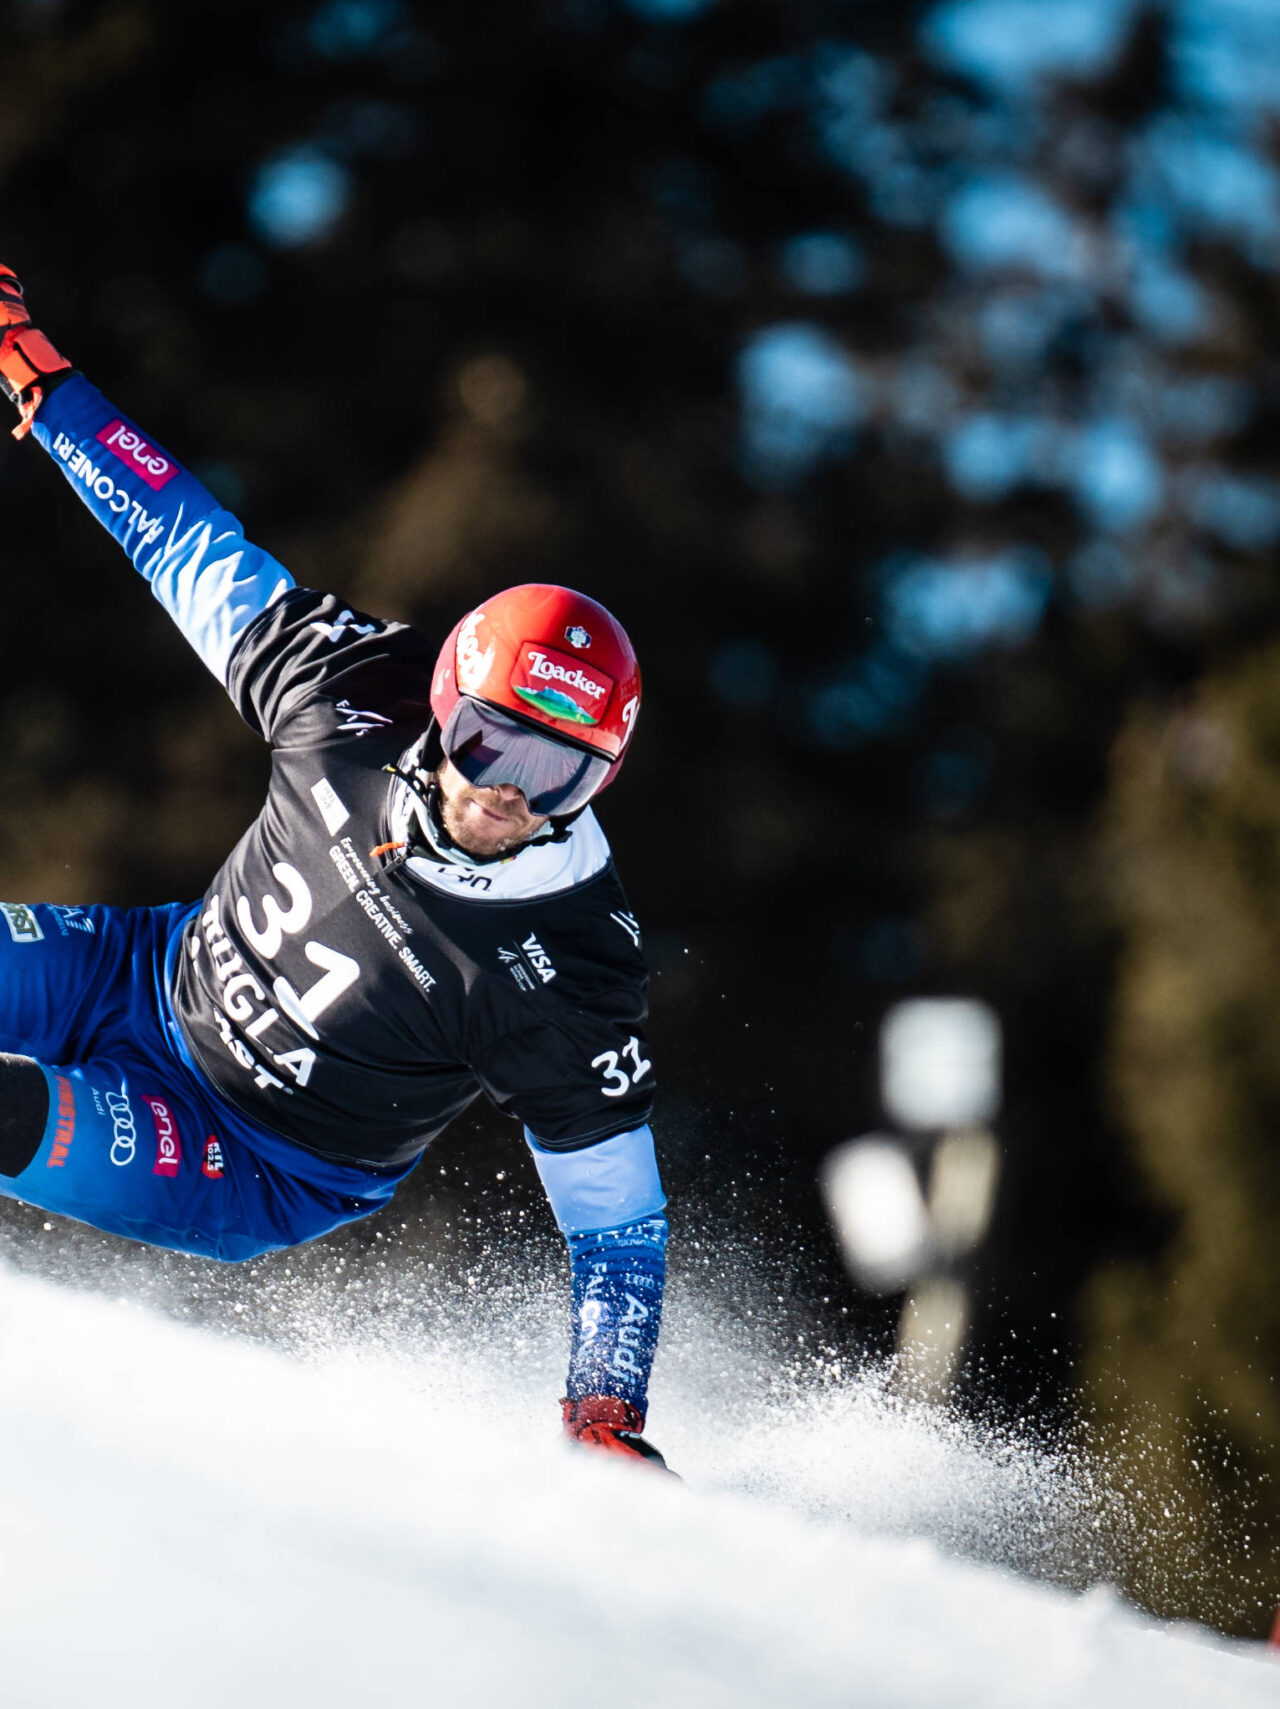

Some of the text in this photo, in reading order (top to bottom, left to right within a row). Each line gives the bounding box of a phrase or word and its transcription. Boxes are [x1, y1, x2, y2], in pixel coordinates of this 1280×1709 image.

[107, 425, 169, 475] enel
[528, 652, 606, 700] Loacker
[236, 861, 360, 1041] 31
[355, 890, 402, 951] CREATIVE.
[399, 946, 437, 993] SMART.
[521, 932, 557, 984] VISA
[591, 1035, 652, 1097] 31
[90, 1087, 106, 1116] Audi
[150, 1101, 178, 1165] enel
[611, 1291, 650, 1385] Audi
